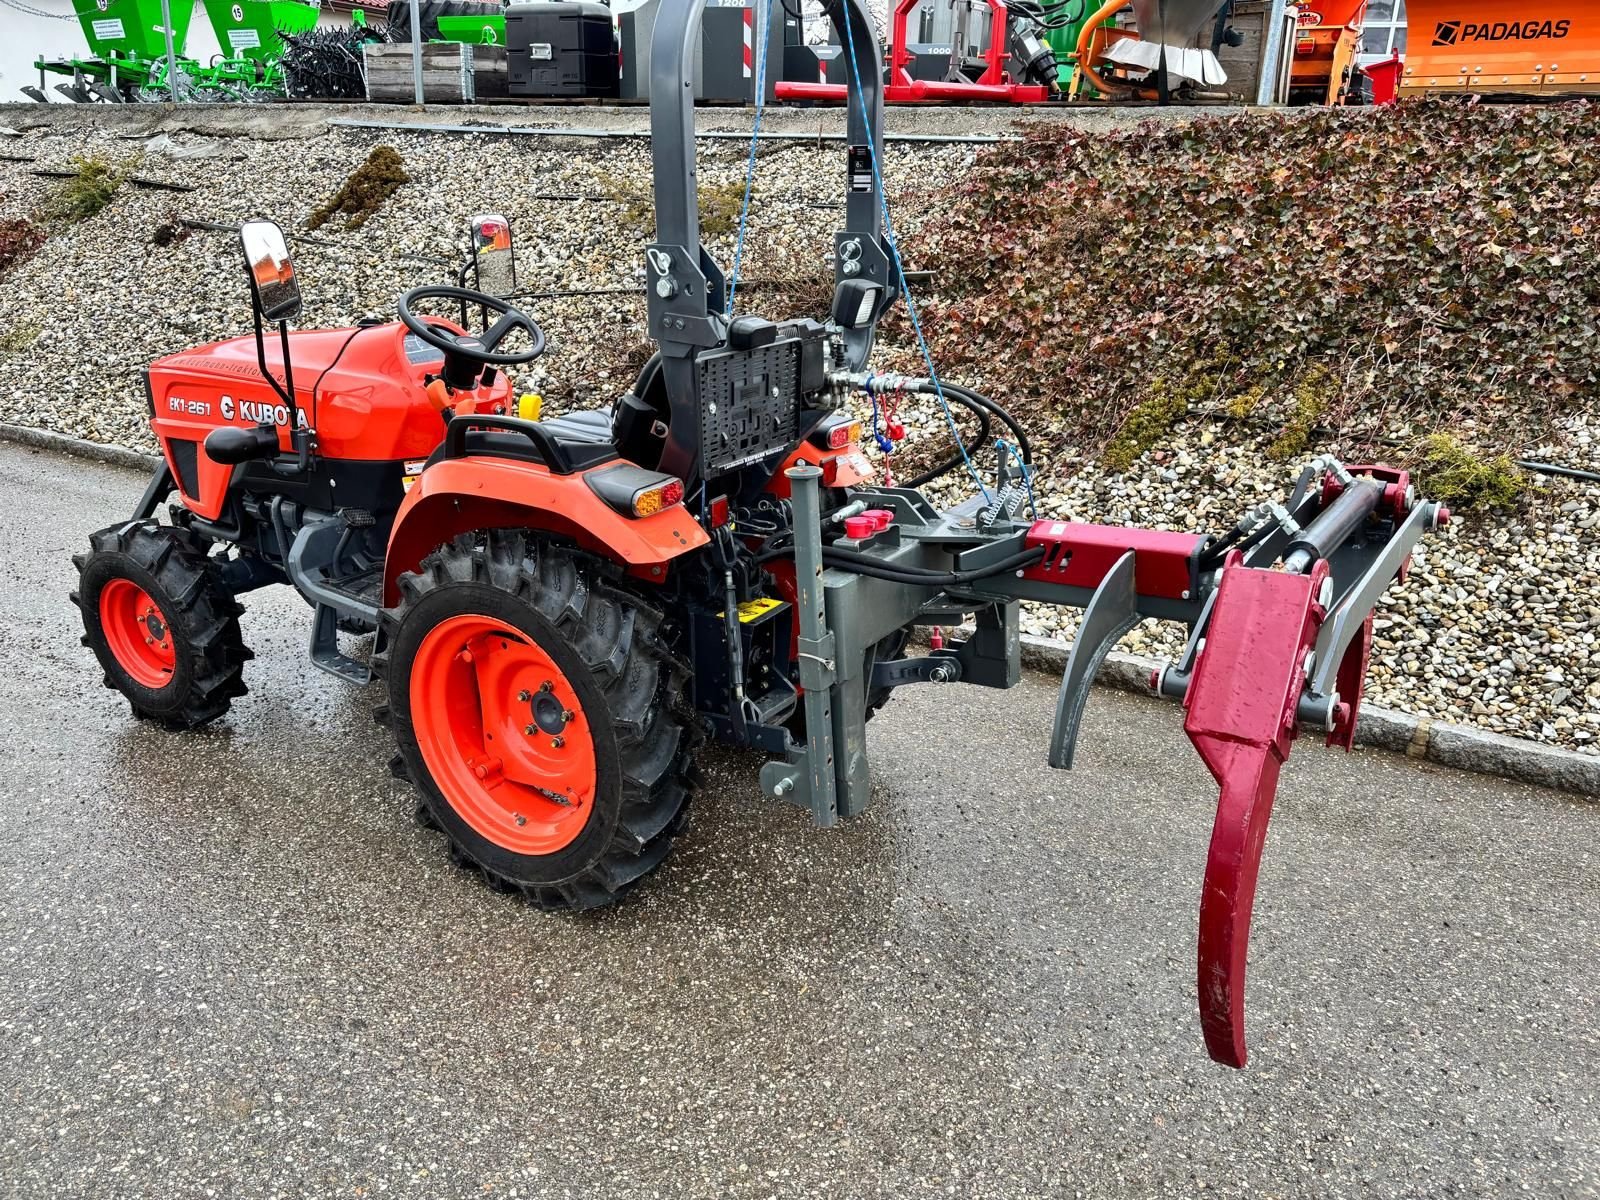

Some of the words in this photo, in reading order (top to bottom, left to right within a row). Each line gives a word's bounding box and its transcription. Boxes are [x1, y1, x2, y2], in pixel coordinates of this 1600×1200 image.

[233, 8, 242, 18] 15
[1461, 20, 1570, 41] PADAGAS
[169, 397, 211, 417] EK1-261
